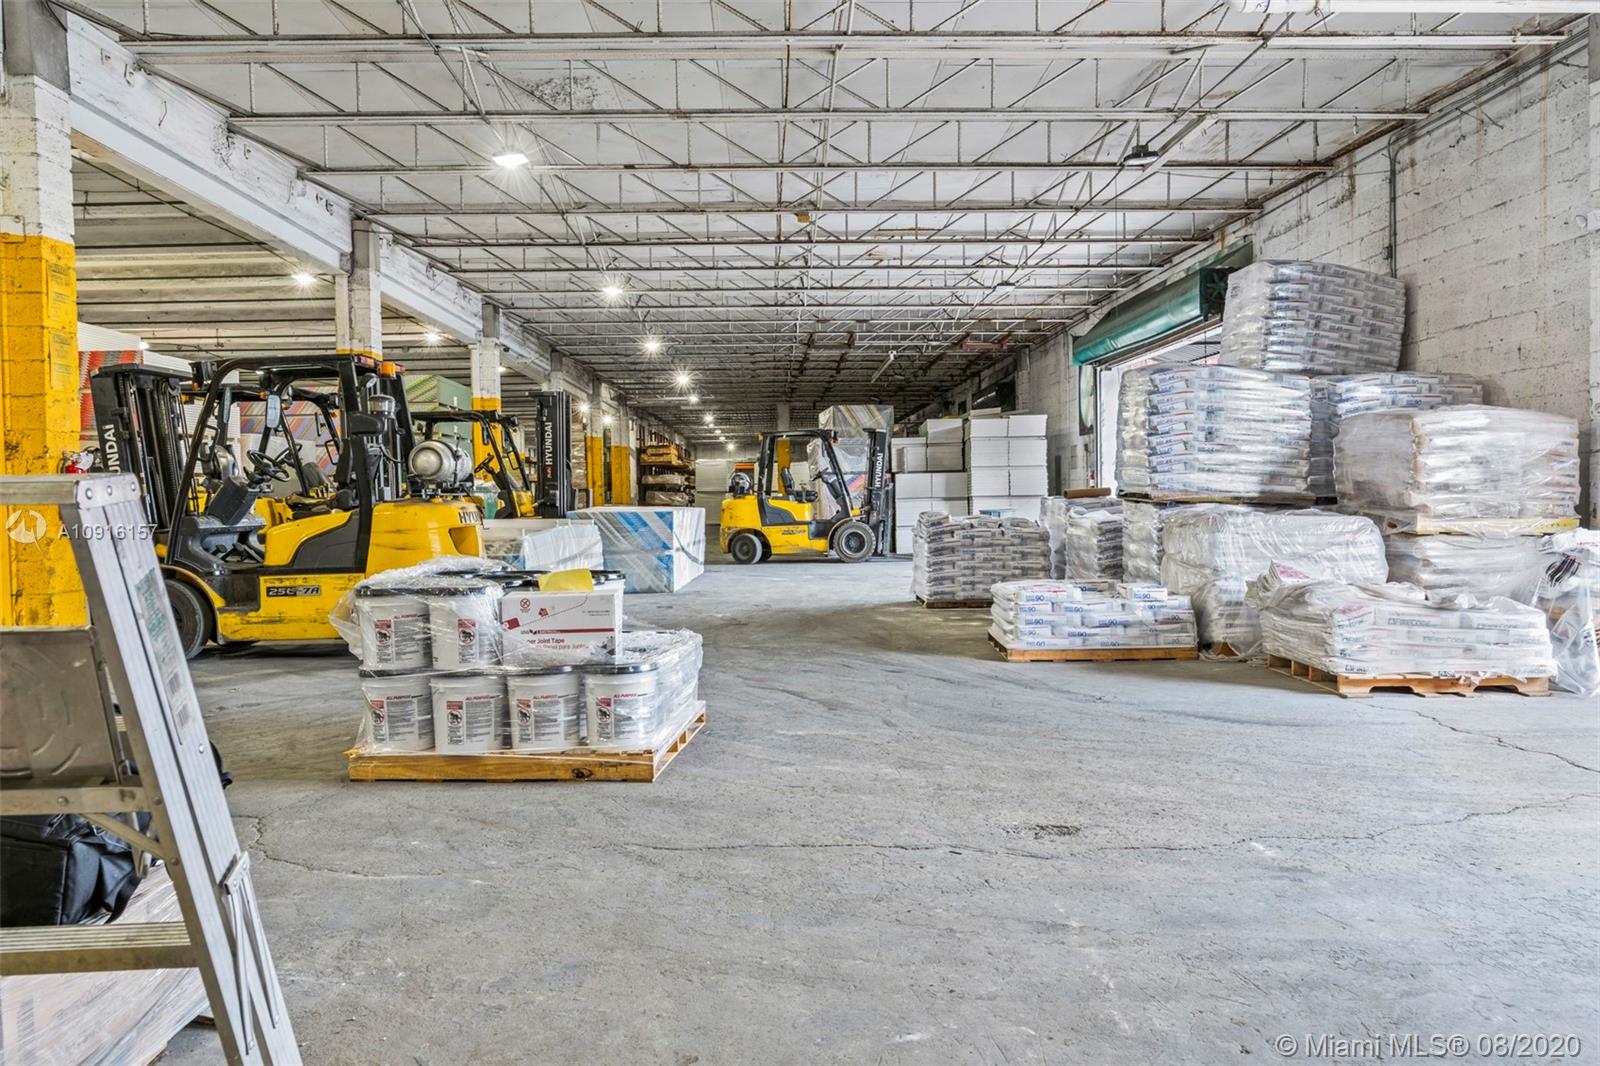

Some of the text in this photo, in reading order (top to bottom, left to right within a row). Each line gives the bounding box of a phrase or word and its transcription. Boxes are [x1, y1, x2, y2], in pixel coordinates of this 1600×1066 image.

[102, 424, 121, 474] UNDAI
[544, 421, 553, 465] HYUNDAI
[874, 452, 884, 488] HYUNDAI
[552, 637, 565, 645] Tape
